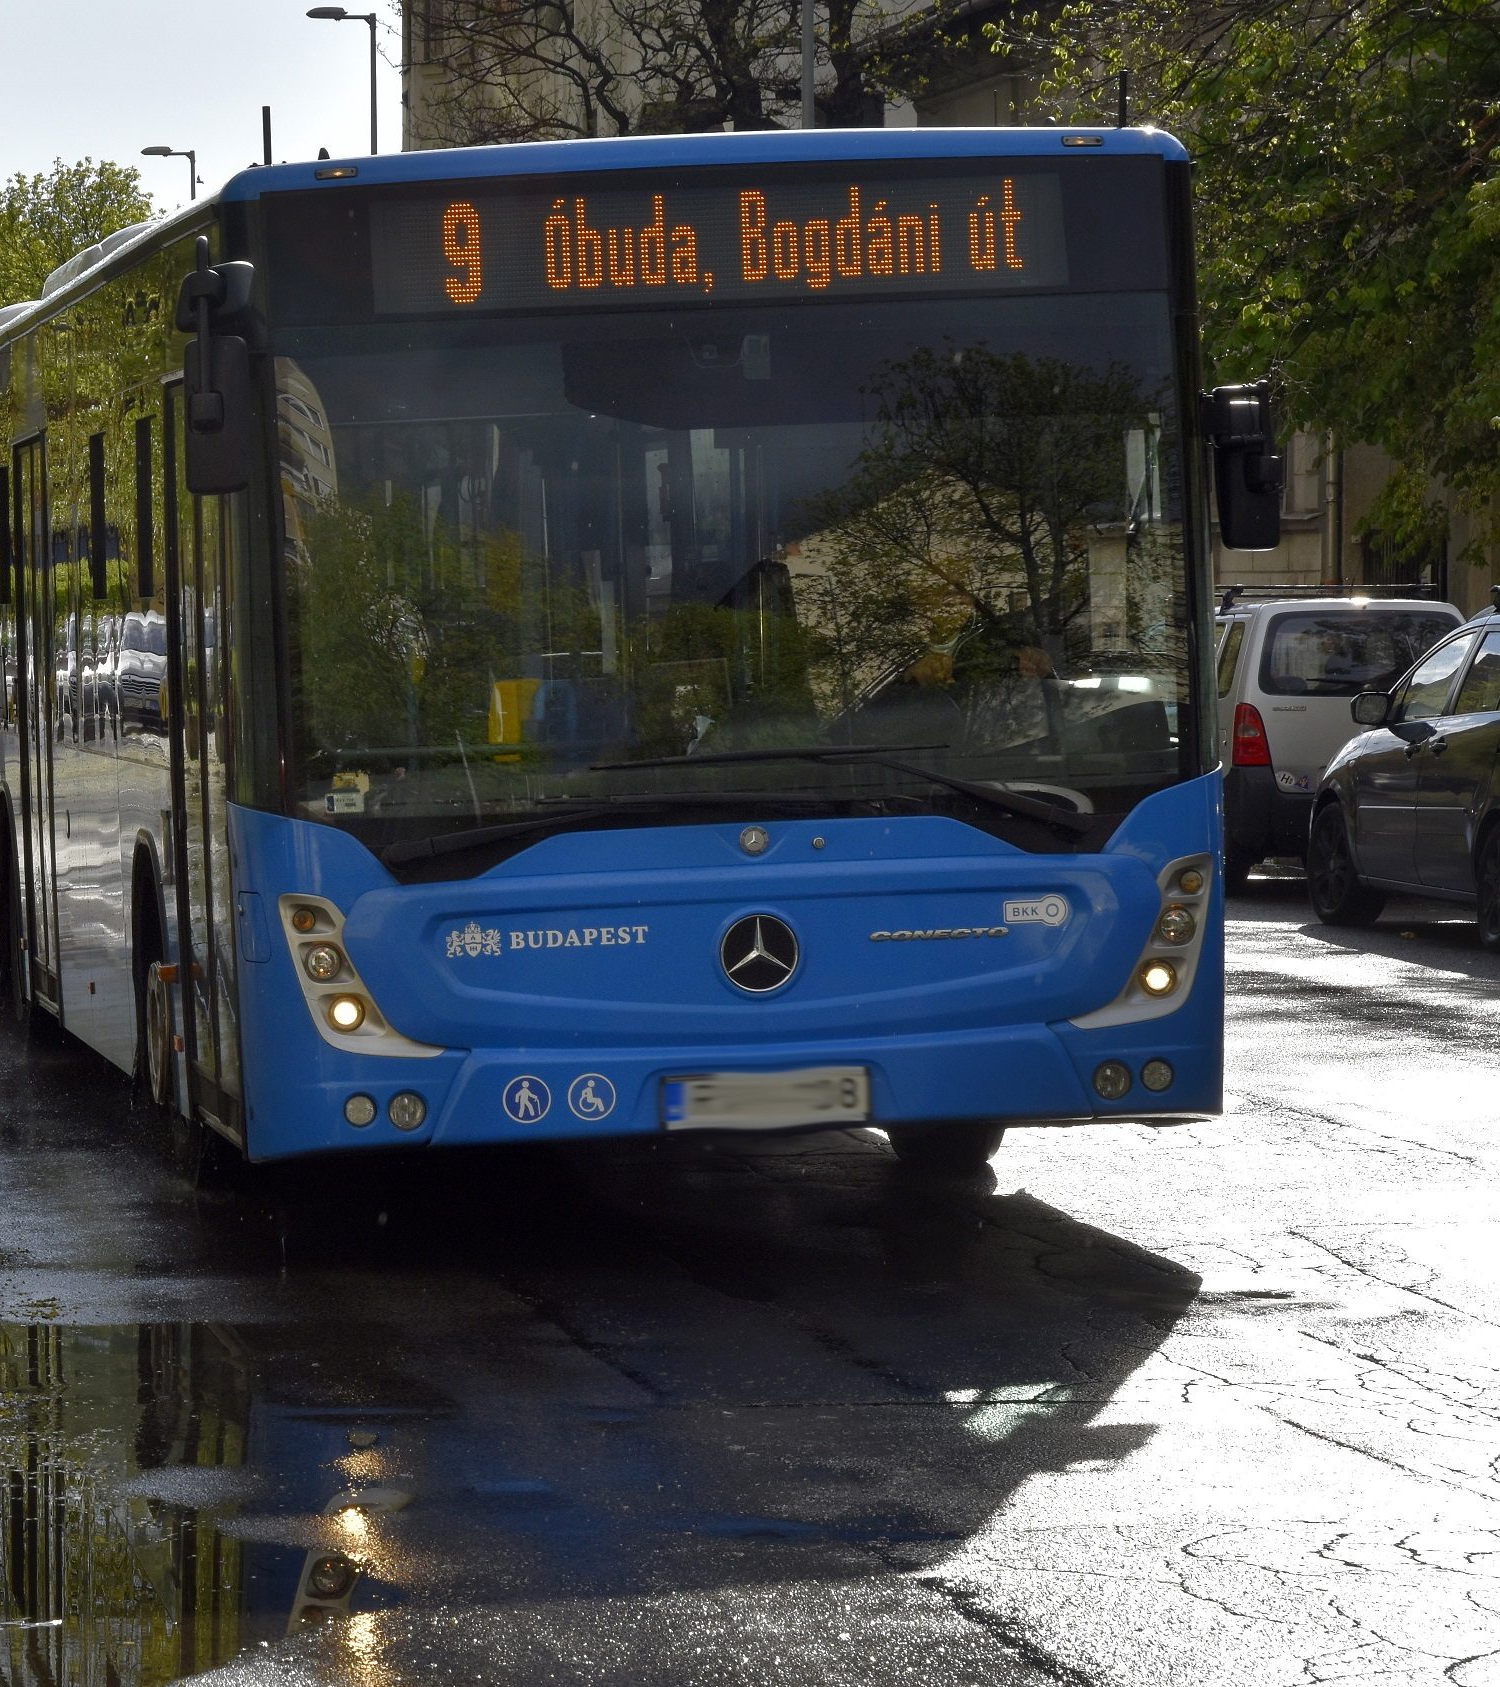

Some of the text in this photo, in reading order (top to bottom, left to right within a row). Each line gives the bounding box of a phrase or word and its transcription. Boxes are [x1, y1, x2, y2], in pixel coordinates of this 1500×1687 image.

[442, 176, 1025, 304] 9 Óbuda, Bogdáni út
[1012, 906, 1039, 918] BKK
[509, 925, 649, 950] BUDAPEST
[869, 926, 1010, 942] CONECTO
